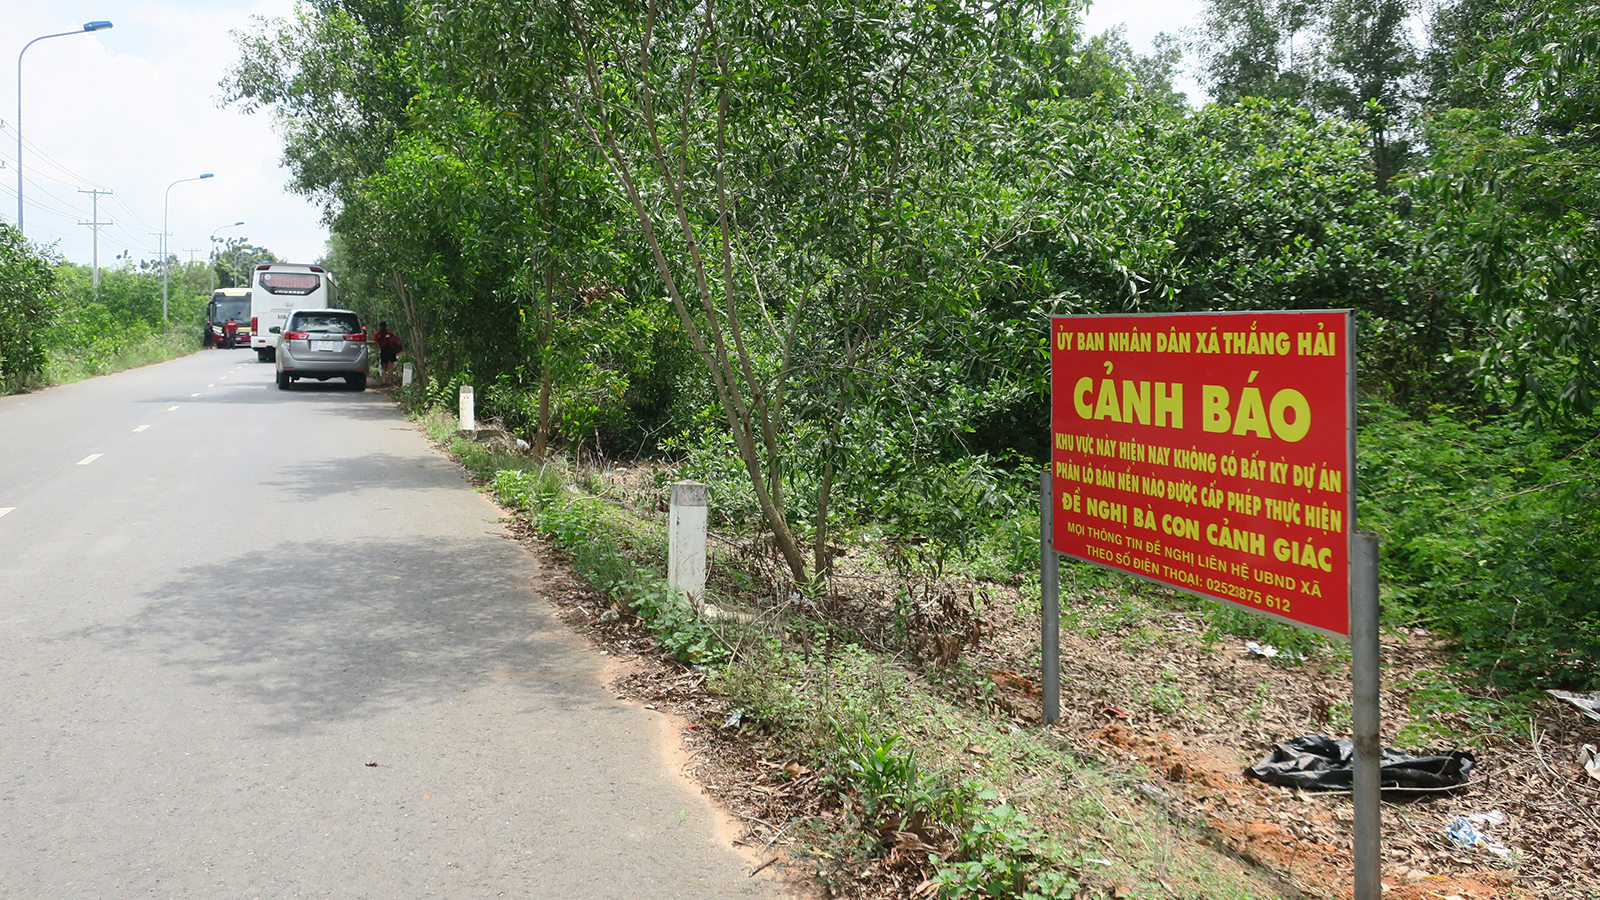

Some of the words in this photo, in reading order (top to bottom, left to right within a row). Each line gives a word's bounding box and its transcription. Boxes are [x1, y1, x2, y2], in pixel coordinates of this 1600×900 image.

[1057, 325, 1074, 351] ỦY
[1077, 332, 1104, 351] BAN
[1109, 326, 1151, 352] NHÂN
[1157, 326, 1191, 353] DÂN
[1195, 326, 1221, 354] XÃ
[1223, 320, 1291, 356] THẮNG
[1297, 322, 1336, 356] HẢI
[1073, 360, 1183, 429] CẢNH
[1202, 370, 1311, 443] BÁO
[1055, 432, 1074, 451] KHU
[1075, 433, 1094, 457] VỰC
[1096, 434, 1117, 458] NÀY
[1119, 437, 1145, 465] HIỆN
[1148, 445, 1171, 466] NAY
[1174, 445, 1217, 474] KHÔNG
[1220, 450, 1238, 477] CÓ
[1241, 450, 1266, 481] BẤT
[1270, 456, 1289, 484] KỲ
[1293, 462, 1316, 494] DỰ
[1318, 461, 1342, 493] ÁN
[1056, 459, 1080, 482] PHÂN
[1082, 462, 1094, 484] LÔ
[1096, 464, 1115, 489] BÁN
[1118, 465, 1139, 493] NỀN
[1142, 472, 1165, 498] NÀO
[1167, 479, 1198, 508] ĐƯỢC
[1201, 480, 1224, 509] CẤP
[1227, 488, 1262, 516] PHÉP
[1265, 498, 1301, 528] THỰC
[1305, 501, 1342, 535] HIỆN
[1062, 487, 1081, 513] ĐỀ
[1087, 497, 1127, 529] NGHỊ
[1133, 504, 1157, 531] BÀ
[1162, 514, 1200, 541] CON
[1206, 517, 1265, 557] CẢNH
[1273, 537, 1332, 572] GIÁC
[1068, 522, 1085, 536] MỌI
[1087, 526, 1122, 545] THÔNG
[1125, 536, 1142, 551] TIN
[1146, 539, 1161, 556] ĐỀ
[1165, 546, 1194, 567] NGHỊ
[1198, 554, 1227, 573] LIÊN
[1231, 562, 1250, 581] HỆ
[1254, 569, 1296, 590] UBND
[1300, 580, 1322, 598] XÃ
[1086, 544, 1113, 561] THEO
[1116, 551, 1131, 566] SỐ
[1133, 557, 1159, 574] ĐIỆN
[1162, 565, 1203, 587] THOẠI:
[1266, 594, 1290, 612] 612
